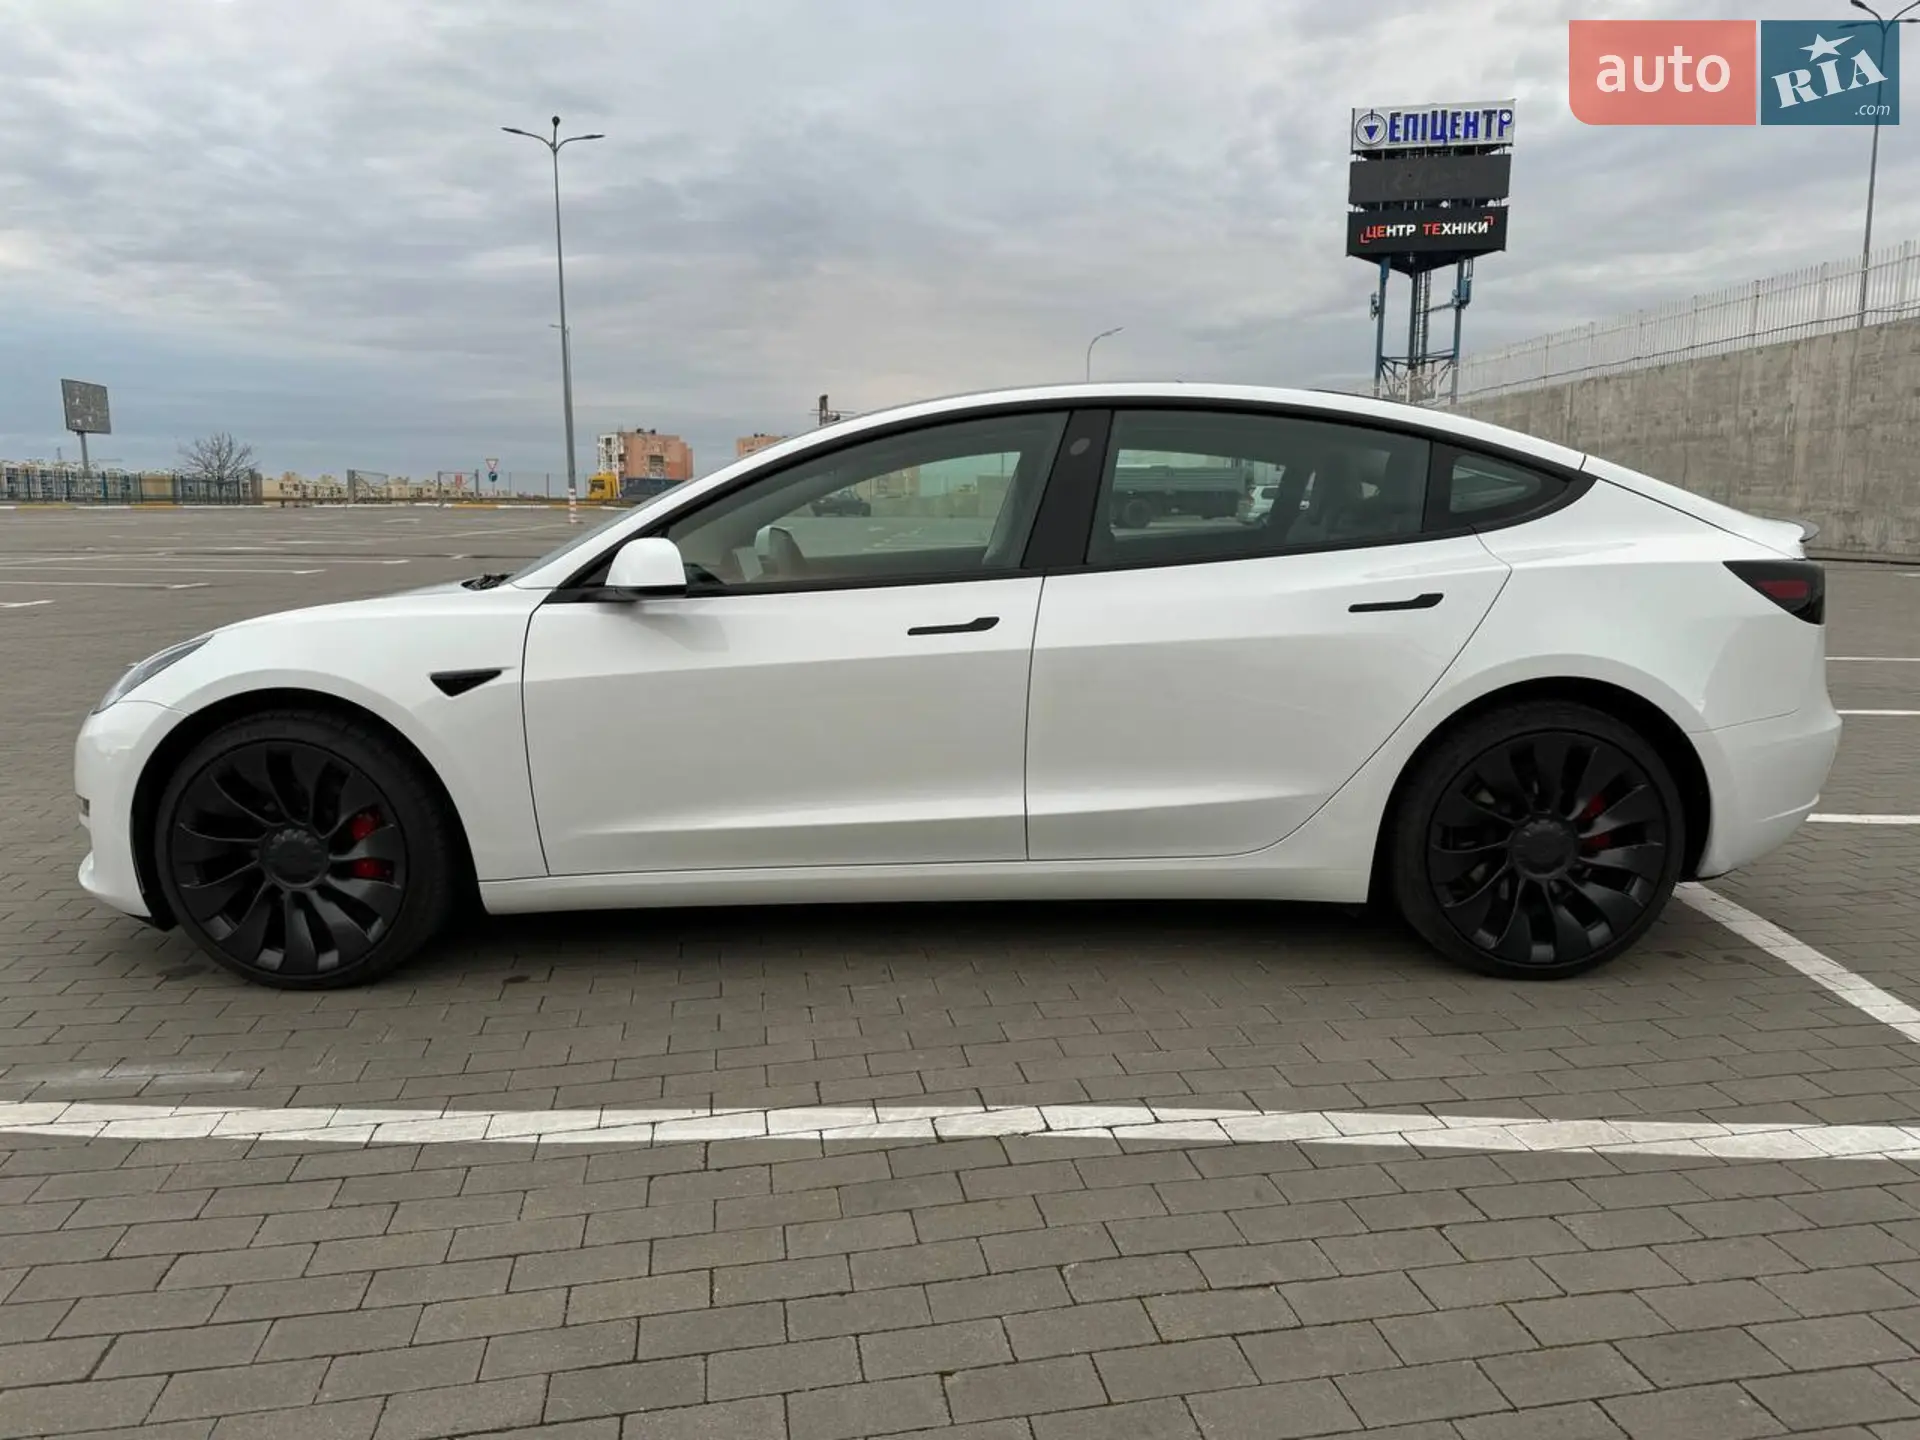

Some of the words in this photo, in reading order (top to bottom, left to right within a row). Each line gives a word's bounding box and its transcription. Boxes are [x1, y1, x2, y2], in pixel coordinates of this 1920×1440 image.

[1388, 109, 1513, 146] ЕПІЦЕНТР
[1366, 223, 1417, 239] ЦЕНТР
[1423, 221, 1489, 236] ТЕХНІКИ
